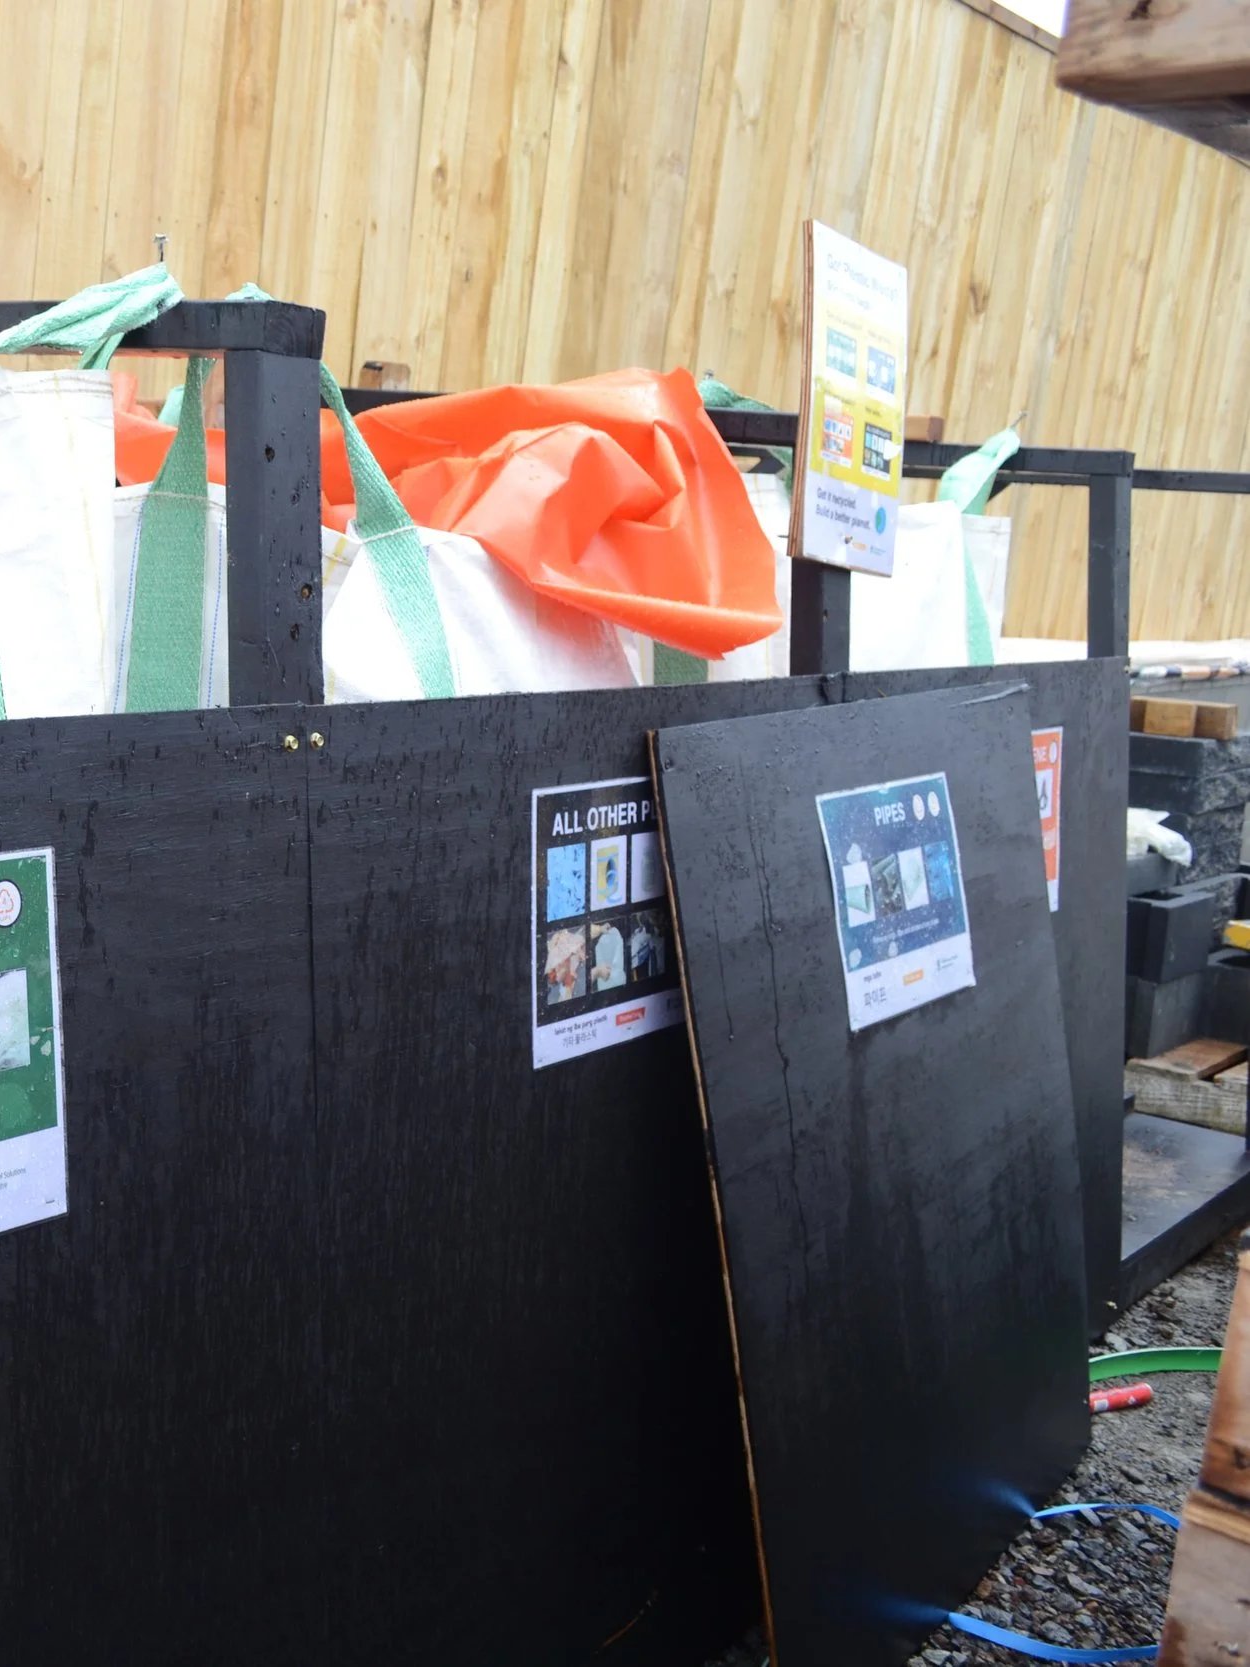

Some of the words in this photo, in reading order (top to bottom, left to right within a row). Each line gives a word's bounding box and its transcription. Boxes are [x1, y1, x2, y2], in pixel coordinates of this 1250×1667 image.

[552, 810, 584, 836] ALL
[587, 801, 638, 831] OTHER
[874, 802, 906, 827] PIPES
